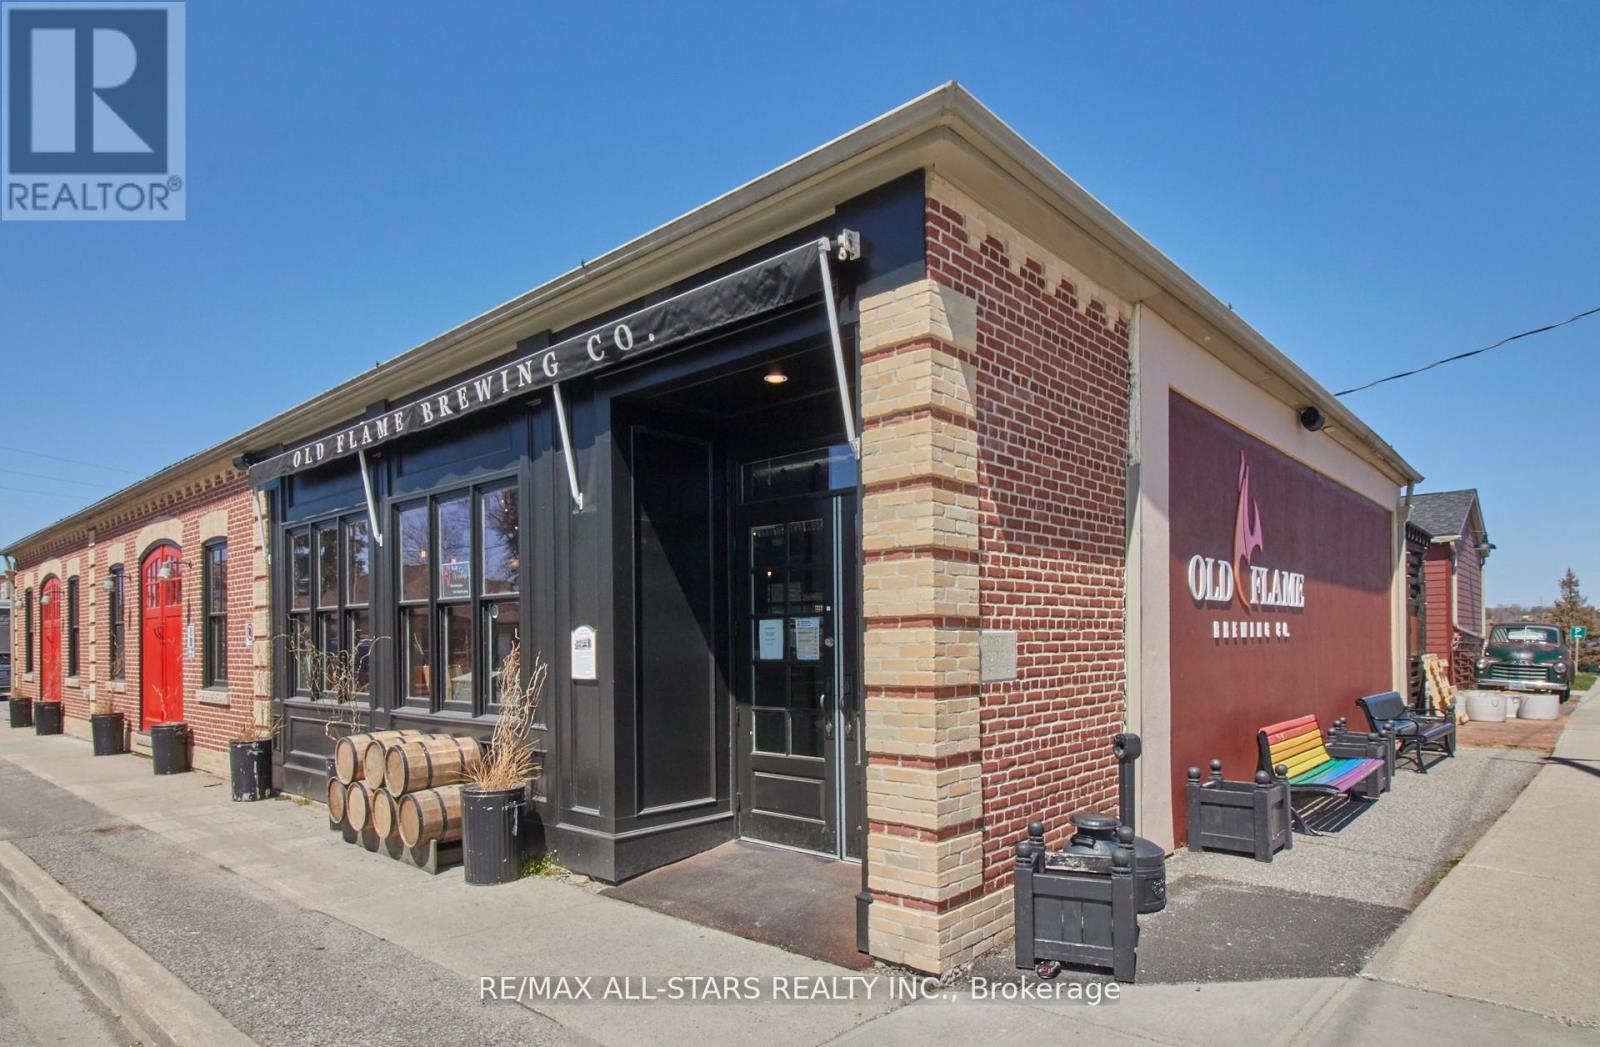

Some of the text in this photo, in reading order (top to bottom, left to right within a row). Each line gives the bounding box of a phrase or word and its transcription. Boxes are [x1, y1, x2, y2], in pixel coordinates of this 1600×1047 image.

[293, 323, 656, 468] OLD FLAME BREWING CO.
[1188, 554, 1305, 607] OLD FLAME
